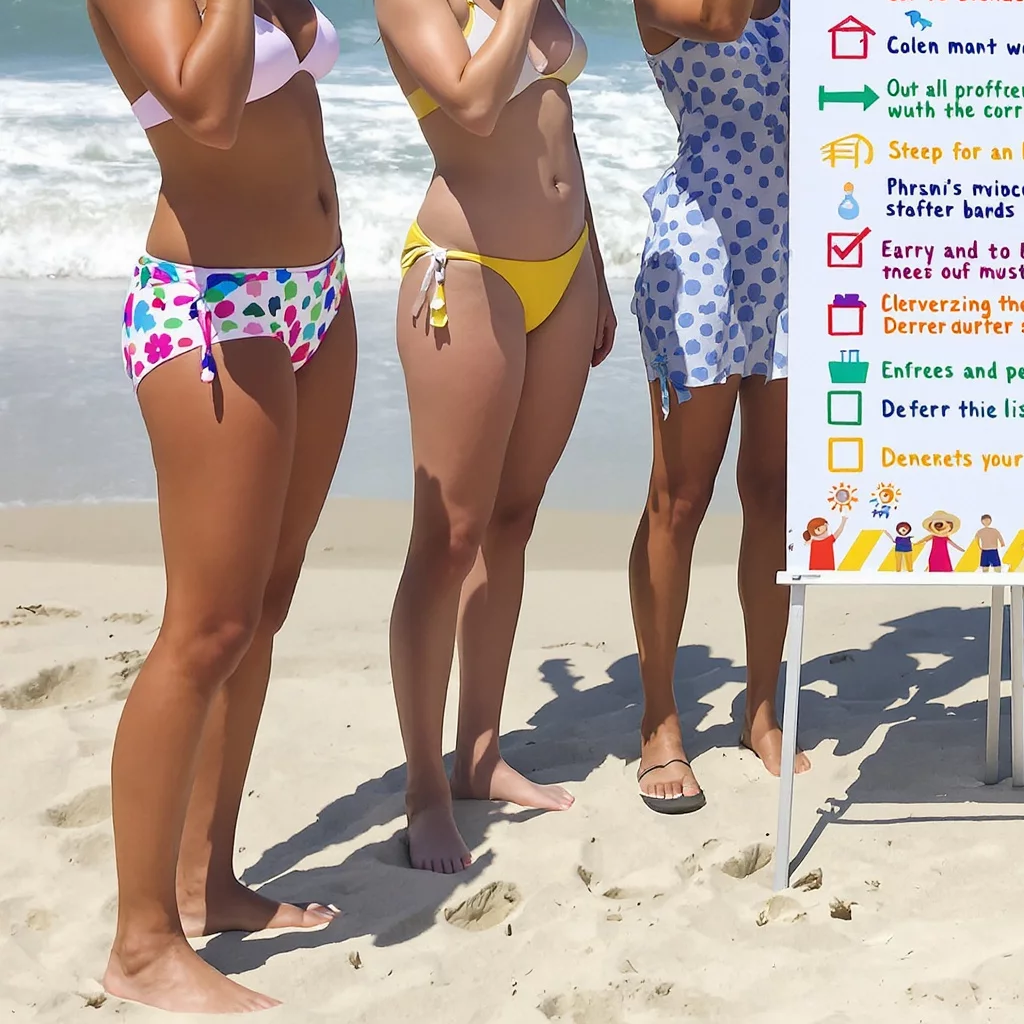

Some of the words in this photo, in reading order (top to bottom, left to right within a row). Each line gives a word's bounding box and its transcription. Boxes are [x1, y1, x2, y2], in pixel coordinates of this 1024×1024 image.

[948, 38, 997, 54] mant
[887, 79, 919, 97] Out
[926, 80, 947, 97] all
[944, 102, 975, 119] the
[953, 142, 982, 160] for
[991, 147, 1013, 161] an
[964, 202, 1014, 219] bards
[882, 240, 934, 267] Earry
[944, 241, 978, 259] and
[988, 244, 1010, 260] to
[941, 263, 970, 280] ouf
[884, 317, 946, 334] Derrer
[964, 361, 997, 379] and
[958, 400, 997, 418] thie
[982, 454, 1023, 472] your
